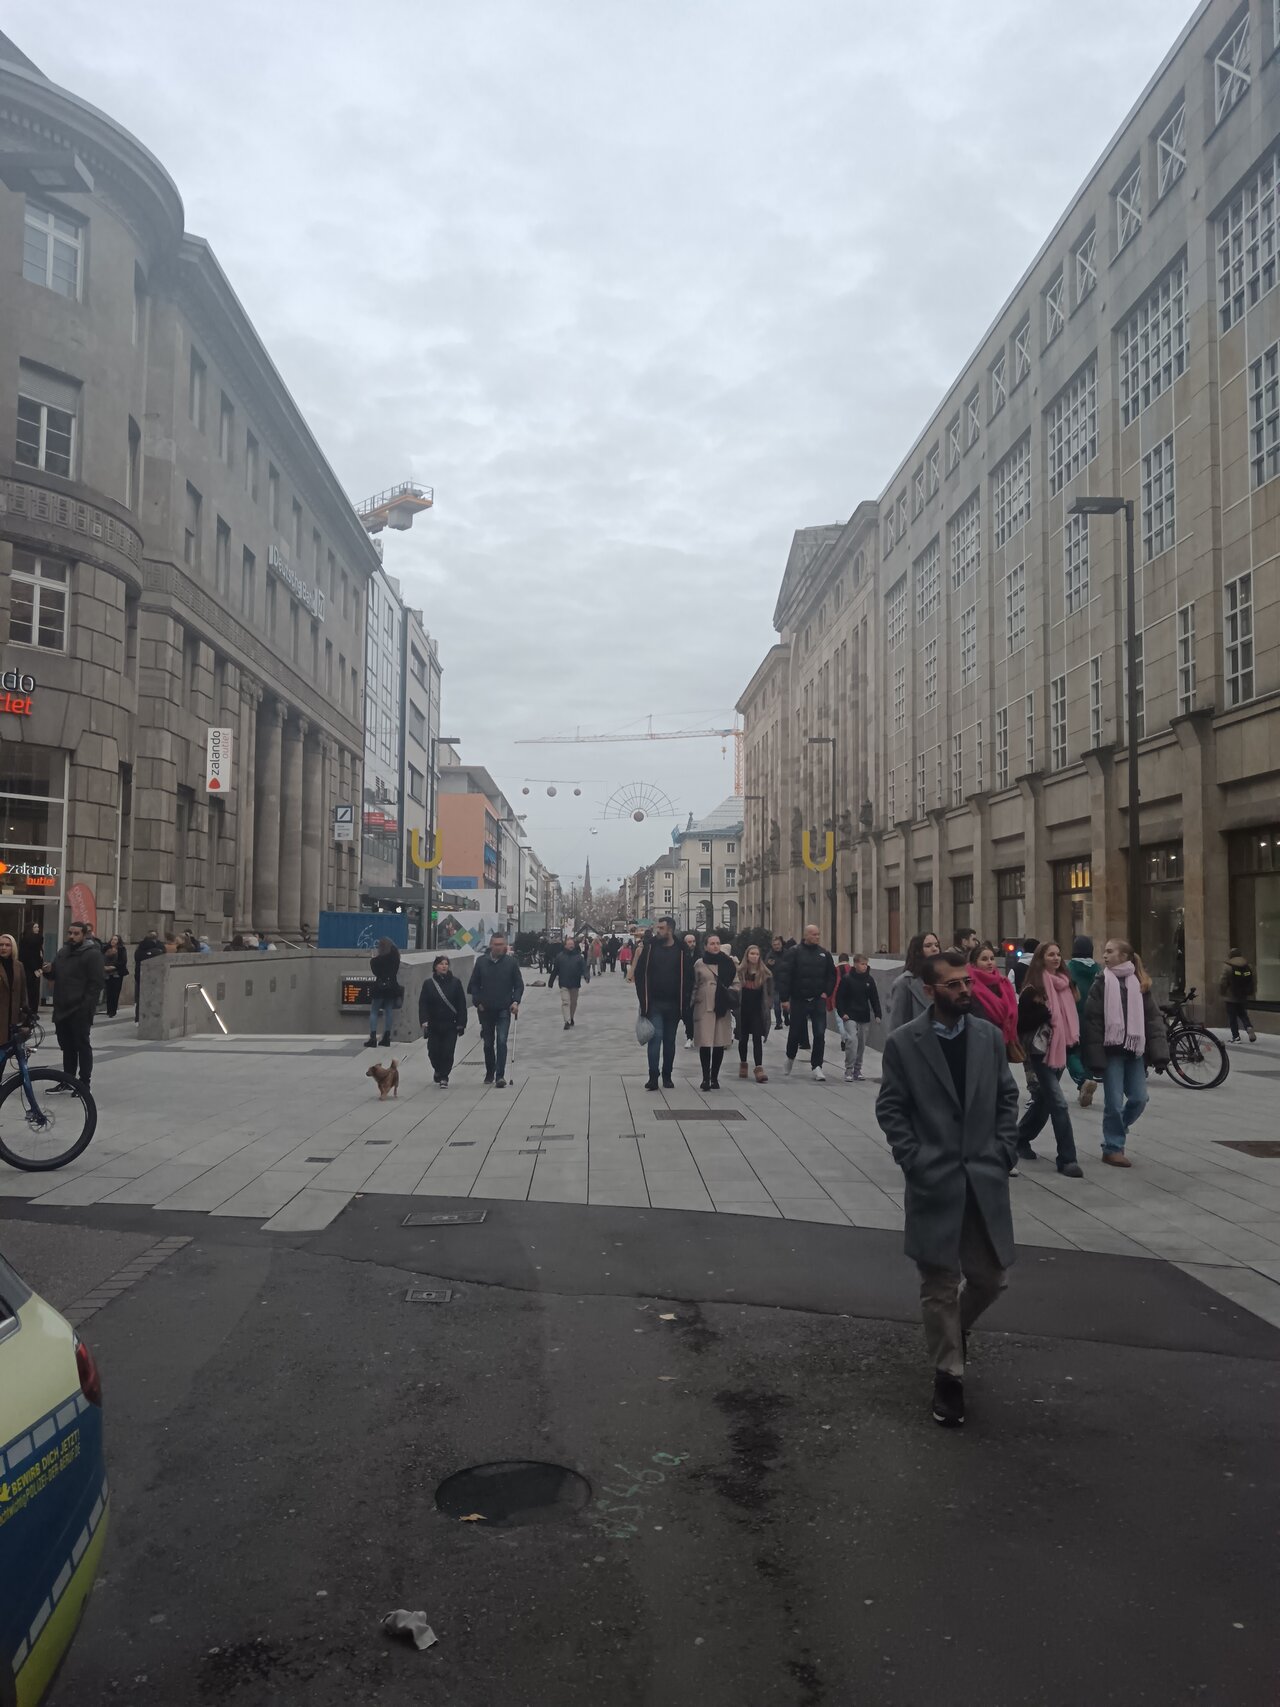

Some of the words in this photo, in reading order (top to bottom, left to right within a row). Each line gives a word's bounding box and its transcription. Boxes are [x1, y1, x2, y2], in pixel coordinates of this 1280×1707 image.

[210, 730, 221, 776] zalando
[221, 732, 230, 759] outlet
[411, 828, 442, 869] U
[802, 831, 834, 871] U
[7, 862, 57, 876] zalando
[26, 876, 56, 887] outlet
[11, 1462, 41, 1496] BEWIRB
[41, 1446, 60, 1471] DICH
[60, 1428, 80, 1455] JETZT!
